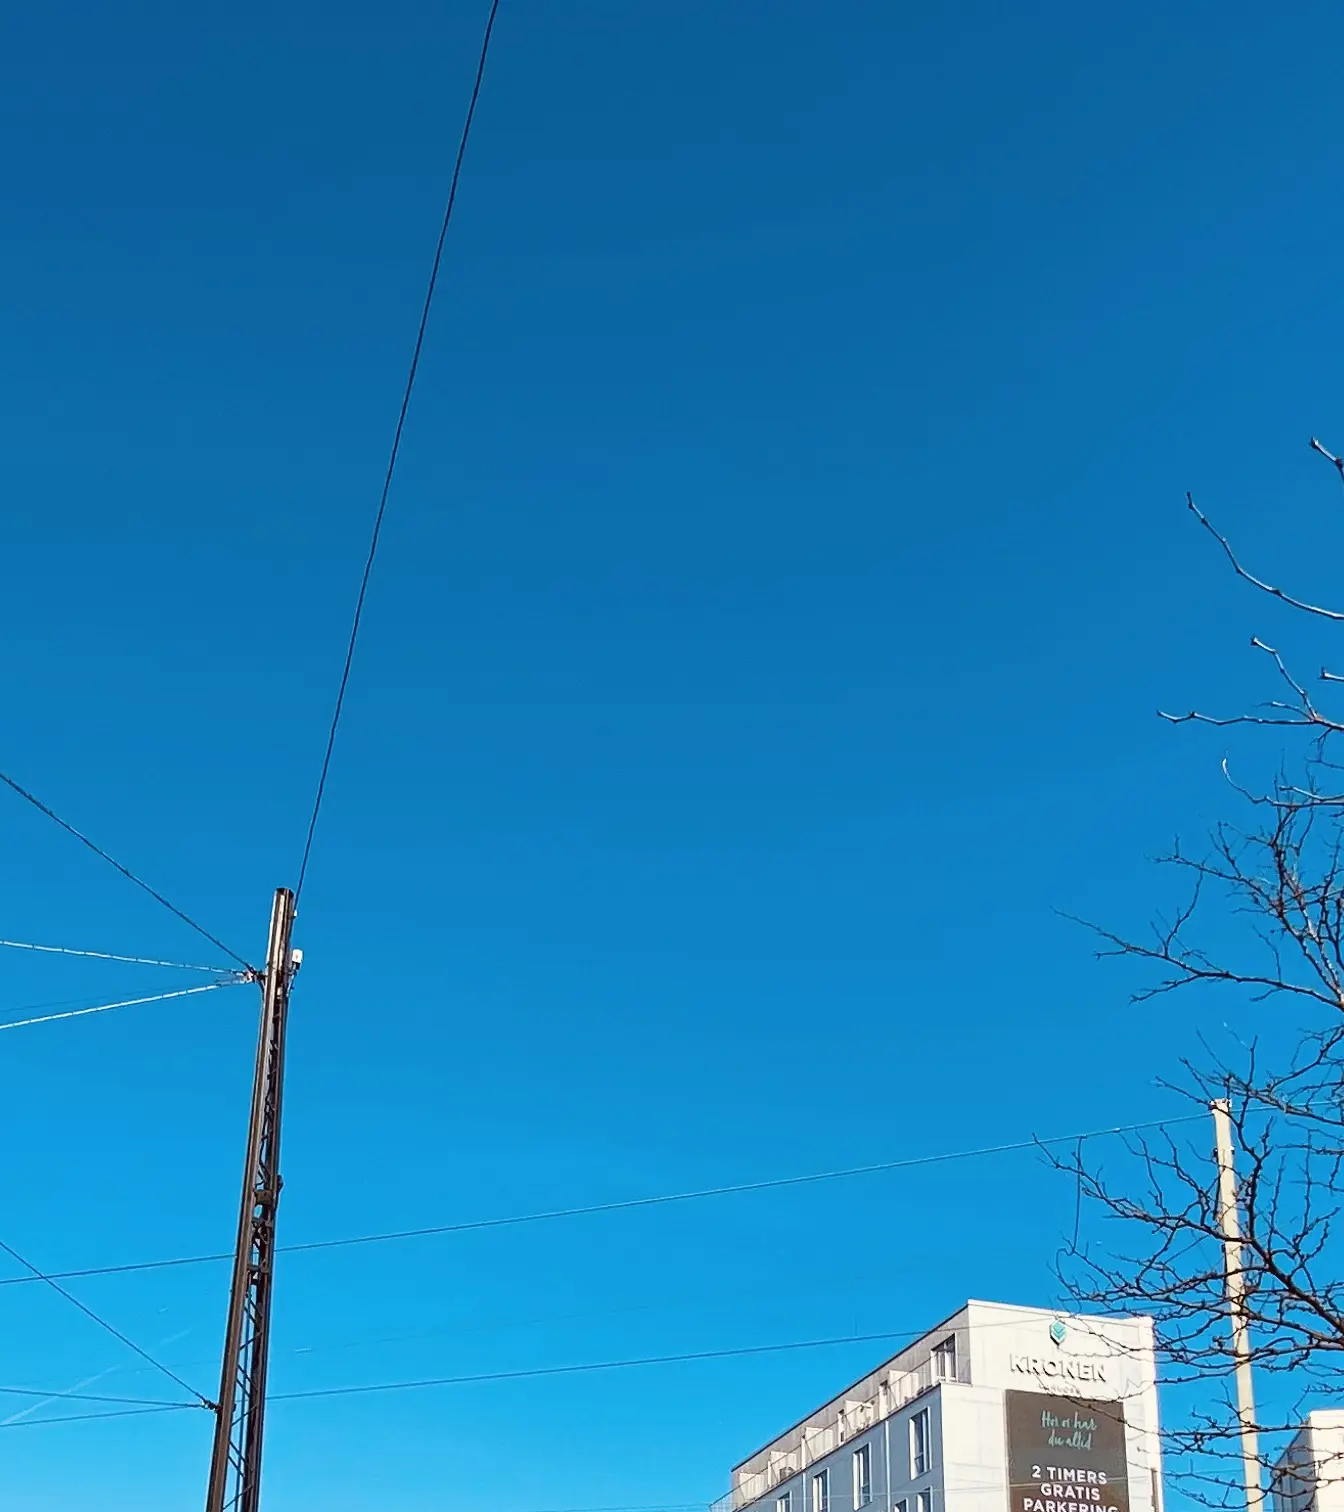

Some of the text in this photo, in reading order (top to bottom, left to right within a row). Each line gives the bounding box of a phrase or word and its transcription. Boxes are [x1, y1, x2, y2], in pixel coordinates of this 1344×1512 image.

[1009, 1354, 1106, 1382] KRONEN
[1031, 1465, 1107, 1485] 2 TIMERS
[1040, 1484, 1101, 1501] GRATIS
